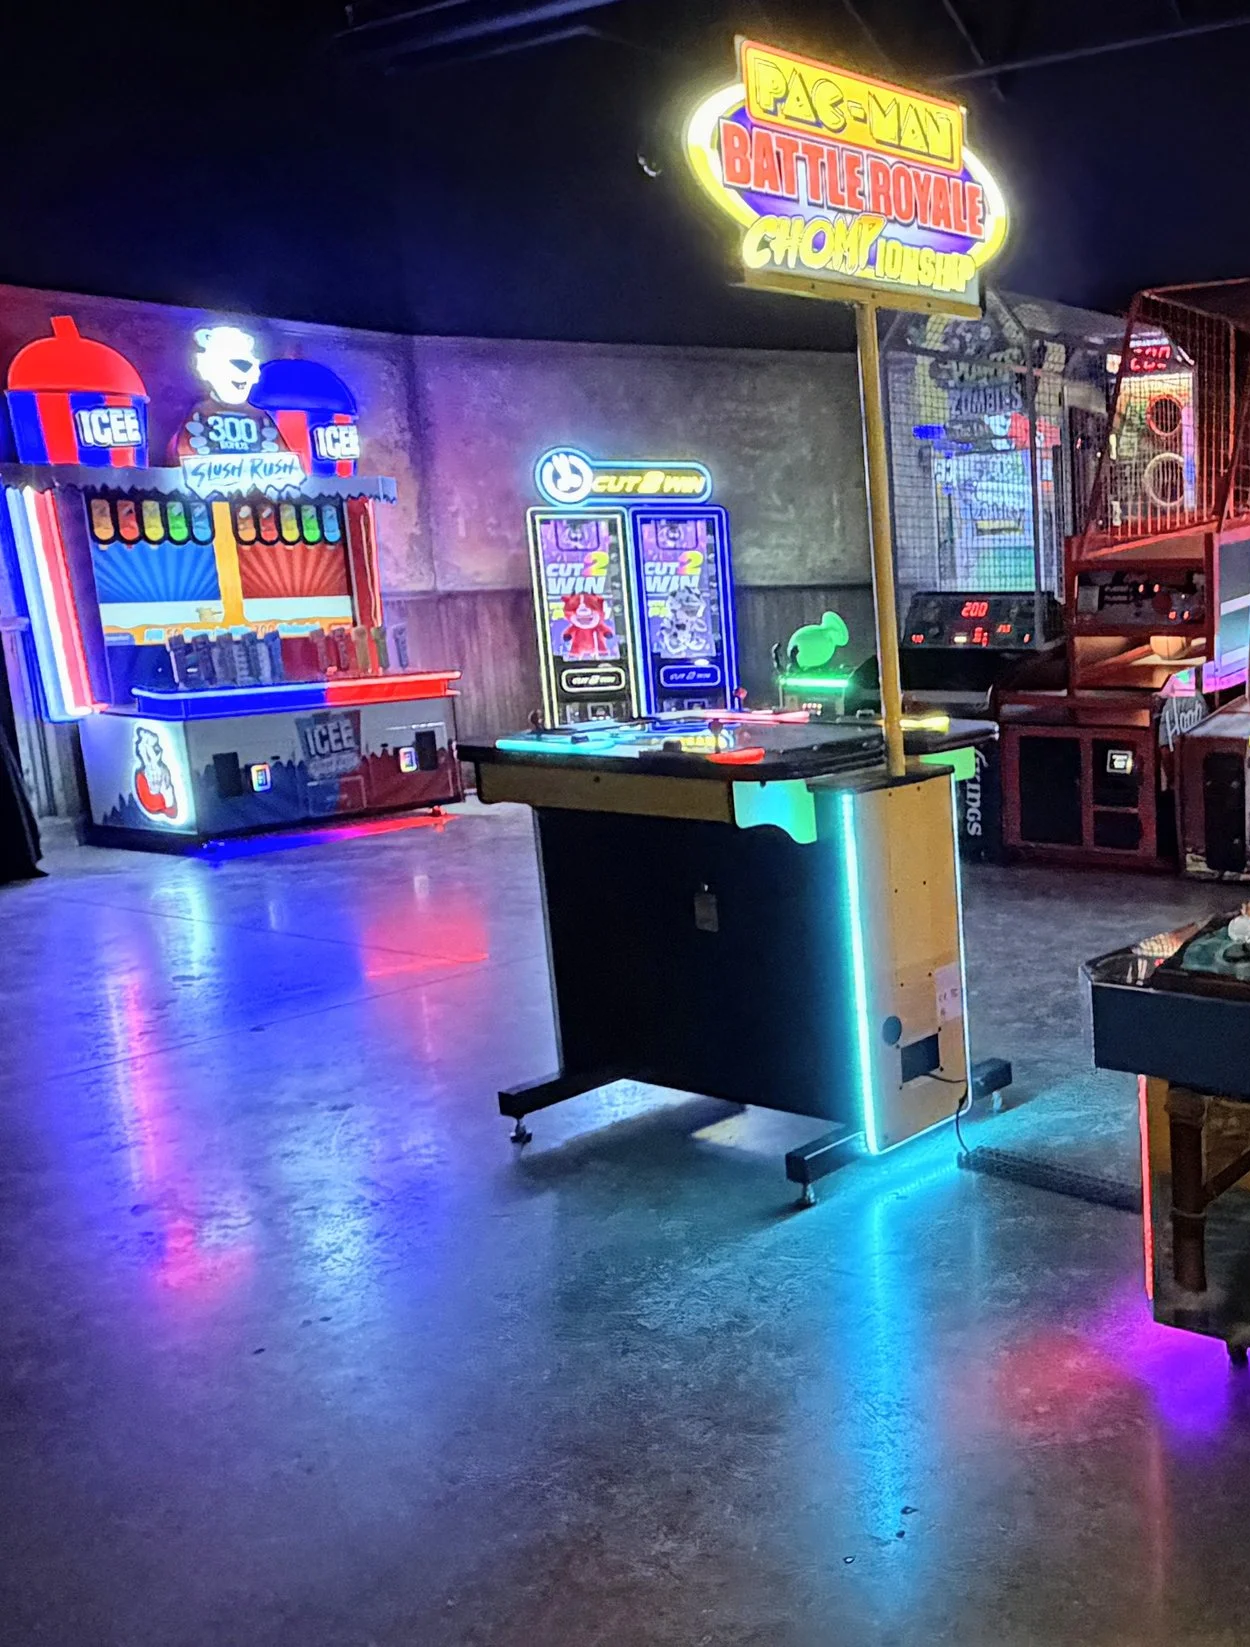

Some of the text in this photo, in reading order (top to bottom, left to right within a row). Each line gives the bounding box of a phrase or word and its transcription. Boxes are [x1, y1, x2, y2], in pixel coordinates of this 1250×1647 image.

[753, 57, 954, 164] PAC-MAN
[720, 121, 985, 239] BATTLE ROYALE
[77, 408, 141, 447] ICEE
[207, 415, 258, 443] 300
[251, 458, 297, 482] RUSH
[546, 551, 609, 577] CUT 2
[644, 550, 704, 576] CUT 2
[547, 577, 606, 595] WIN
[645, 576, 700, 595] WIN
[961, 601, 989, 618] 200
[304, 718, 355, 757] ICEE
